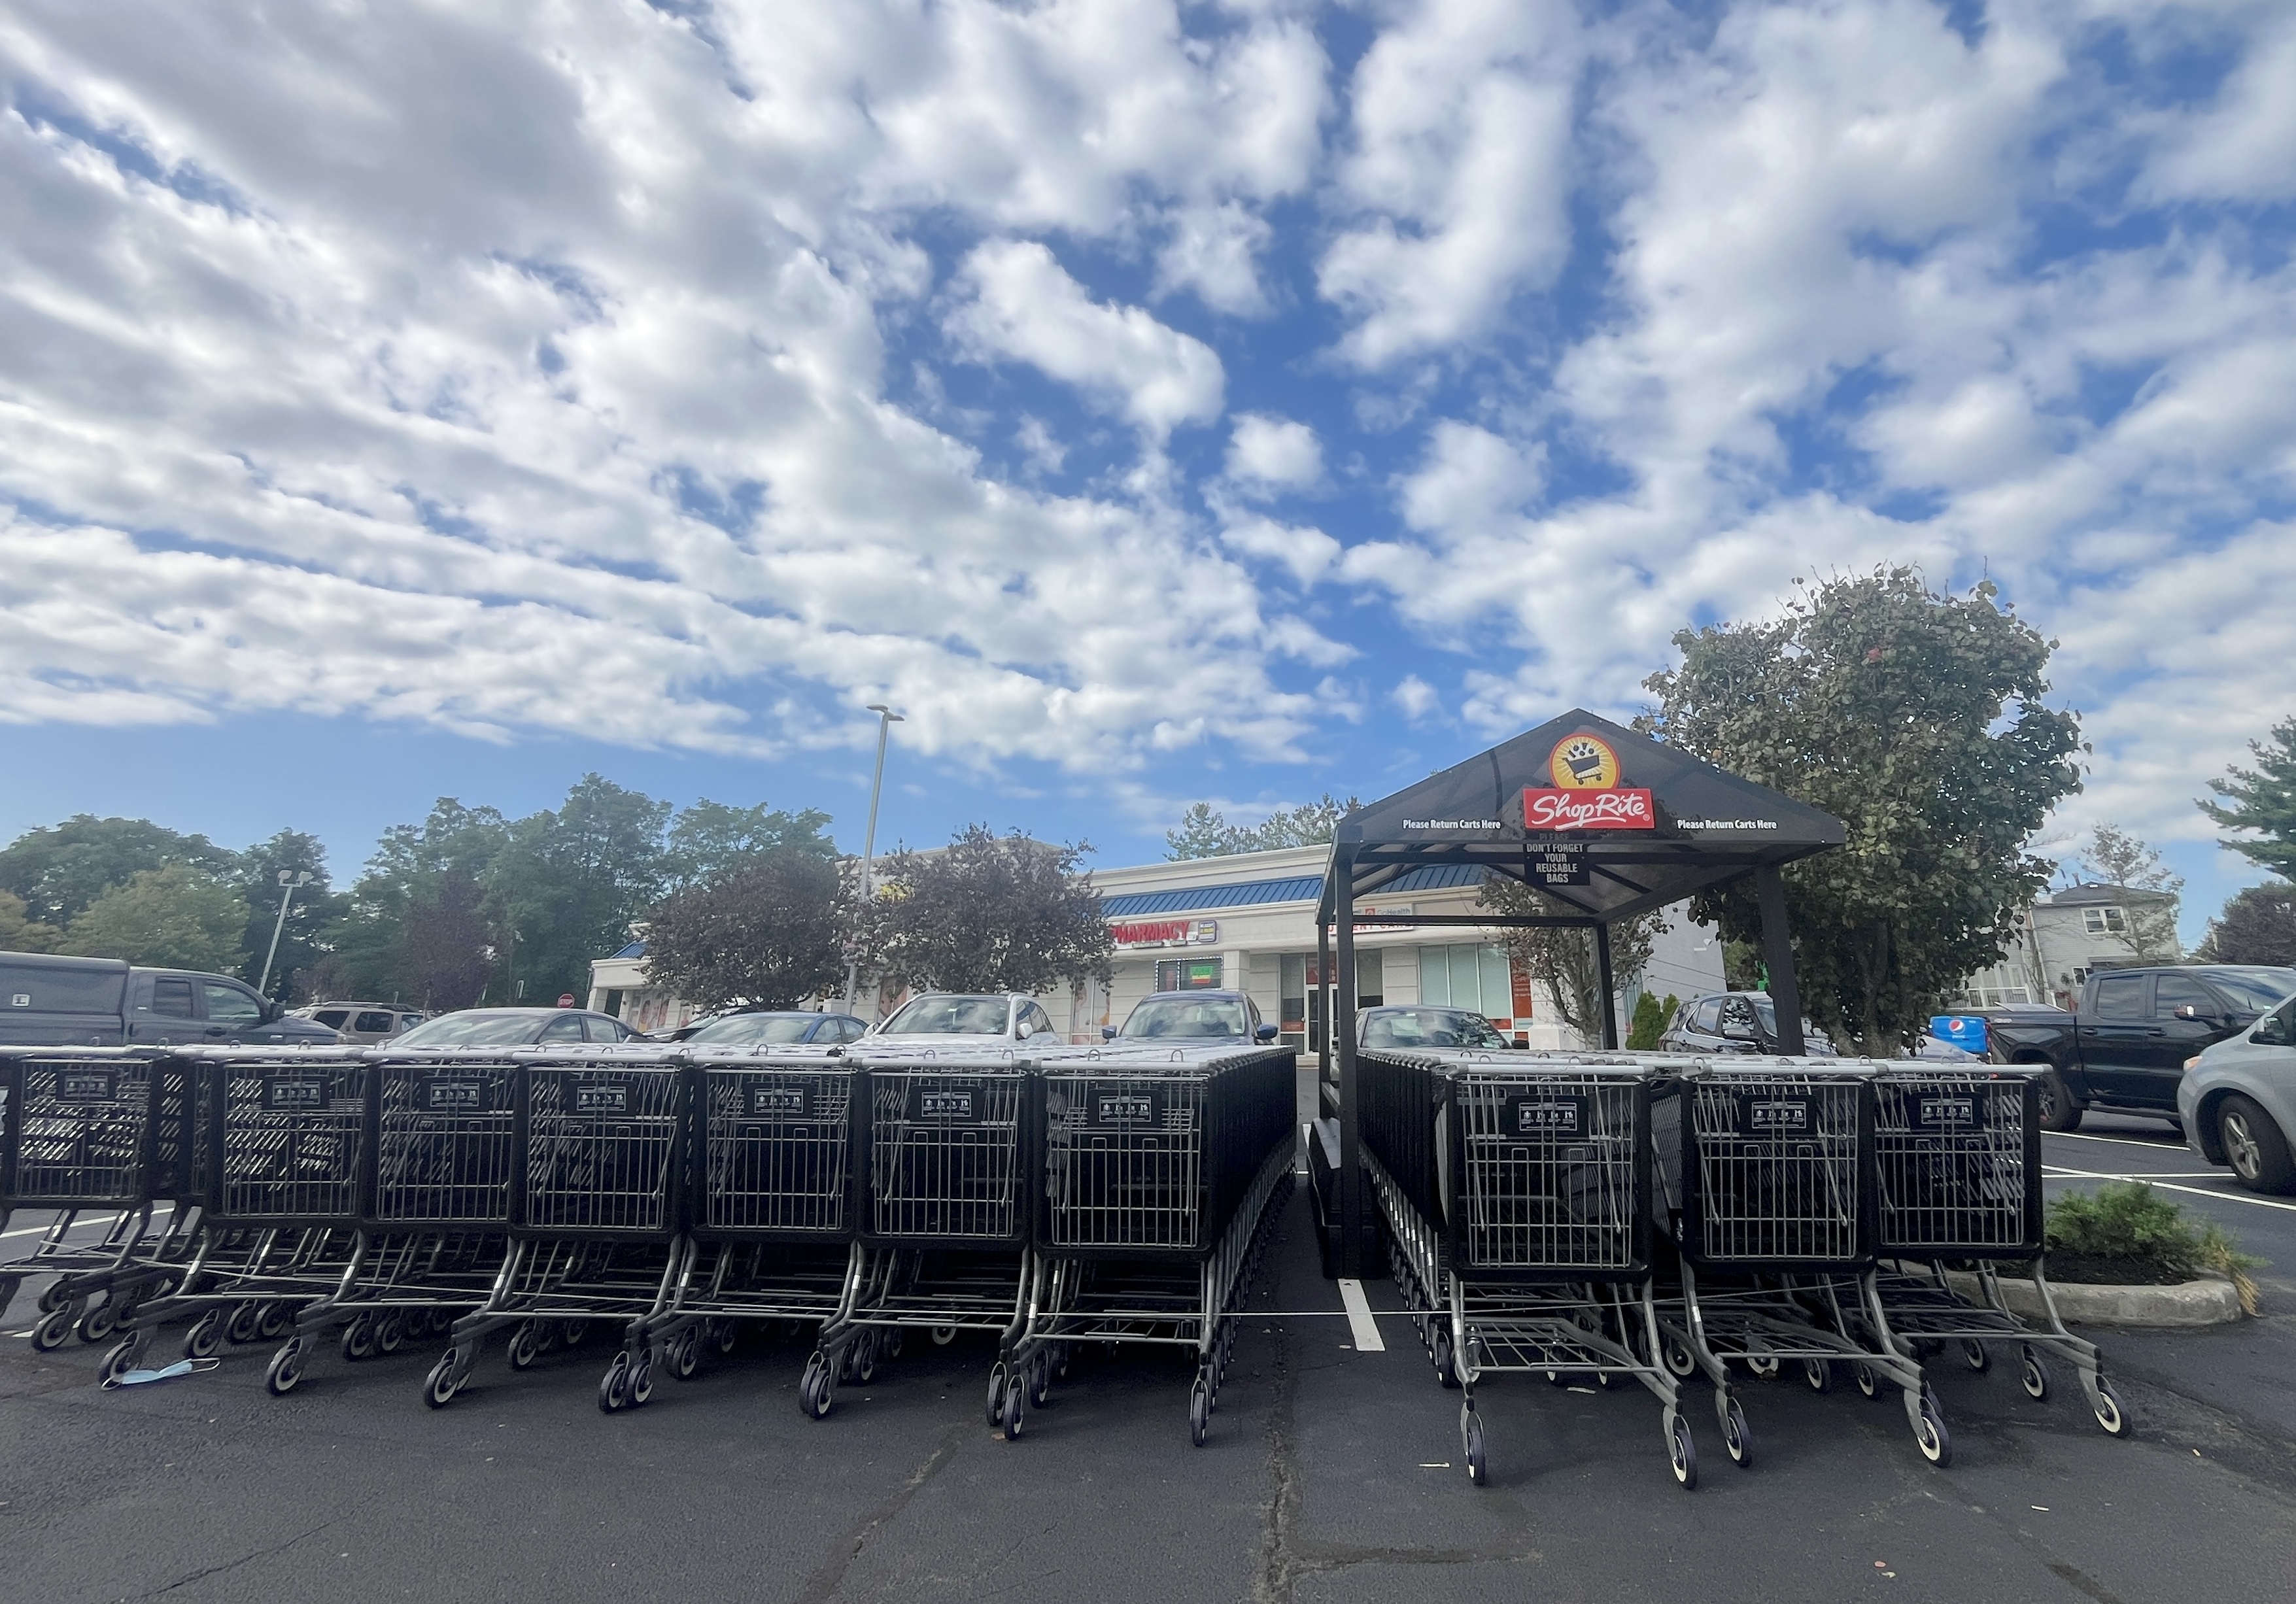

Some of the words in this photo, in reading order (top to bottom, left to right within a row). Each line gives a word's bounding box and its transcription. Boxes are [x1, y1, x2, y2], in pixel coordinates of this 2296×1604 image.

[1531, 793, 1645, 827] ShopRite
[1403, 819, 1430, 829] Please
[1430, 819, 1458, 829] Return
[1459, 819, 1481, 829] Carts
[1481, 819, 1501, 829] Here
[1677, 819, 1704, 829] Please
[1705, 819, 1734, 829] Return
[1734, 819, 1756, 829] Carts
[1756, 819, 1777, 829] Here
[1526, 844, 1550, 853] DON'T
[1552, 844, 1584, 853] FORGET
[1545, 853, 1567, 862] YOUR
[1535, 863, 1578, 873] REUSABLE
[1547, 874, 1569, 883] BAGS
